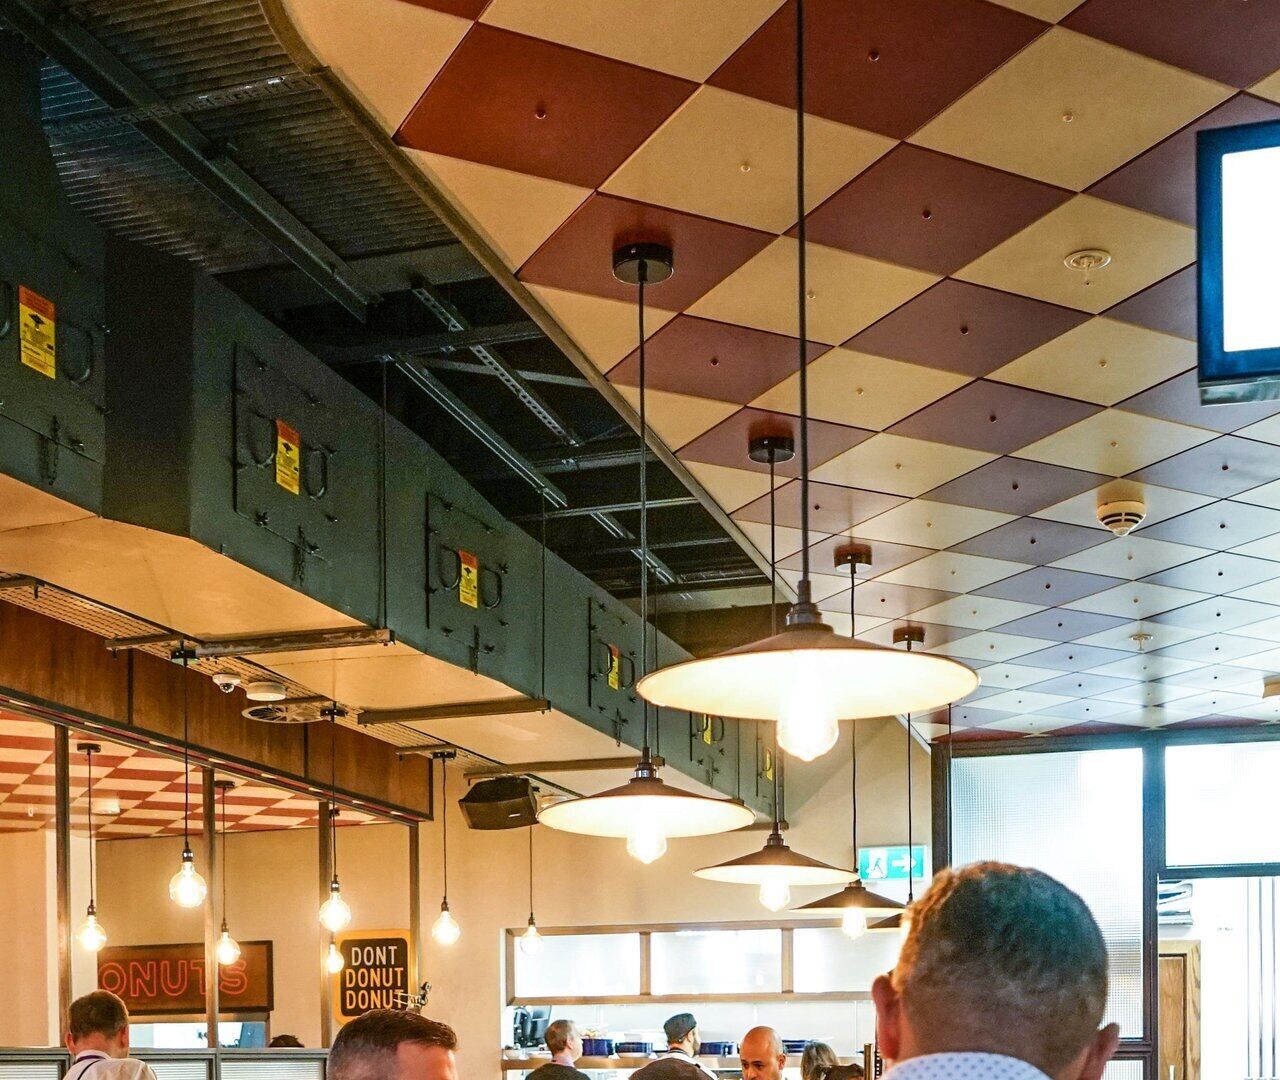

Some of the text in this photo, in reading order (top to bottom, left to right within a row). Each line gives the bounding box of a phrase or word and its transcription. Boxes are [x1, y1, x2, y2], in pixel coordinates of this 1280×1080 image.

[351, 946, 398, 966] DONT
[345, 967, 404, 988] DONUT
[346, 989, 404, 1010] DONUT
